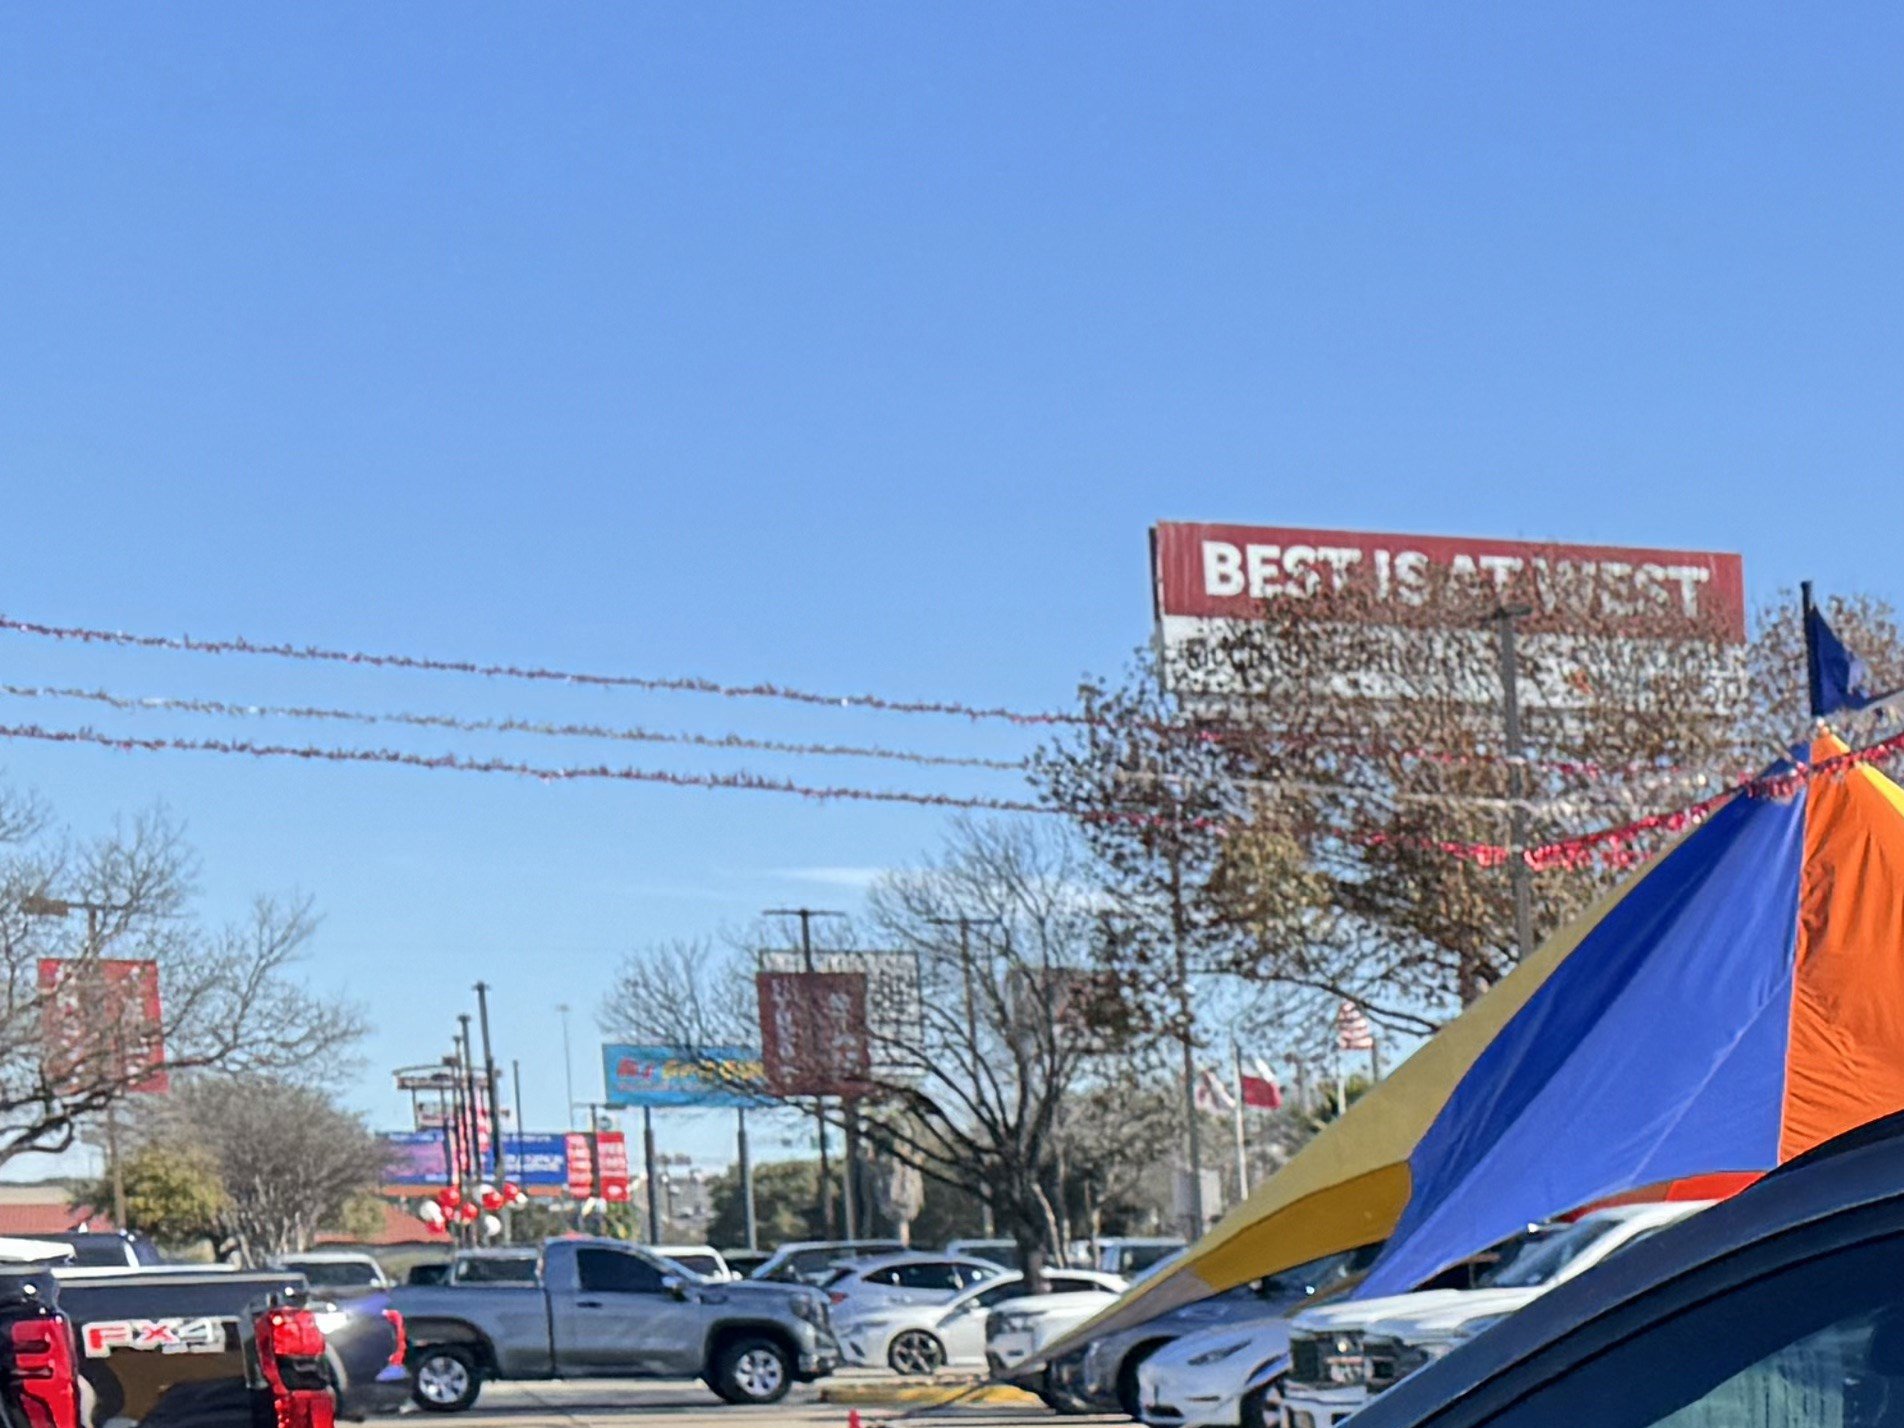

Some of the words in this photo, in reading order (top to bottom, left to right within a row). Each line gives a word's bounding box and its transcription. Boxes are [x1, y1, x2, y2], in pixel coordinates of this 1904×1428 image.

[1202, 540, 1362, 598] BEST
[1374, 550, 1430, 606] IS
[82, 1316, 227, 1358] FX4
